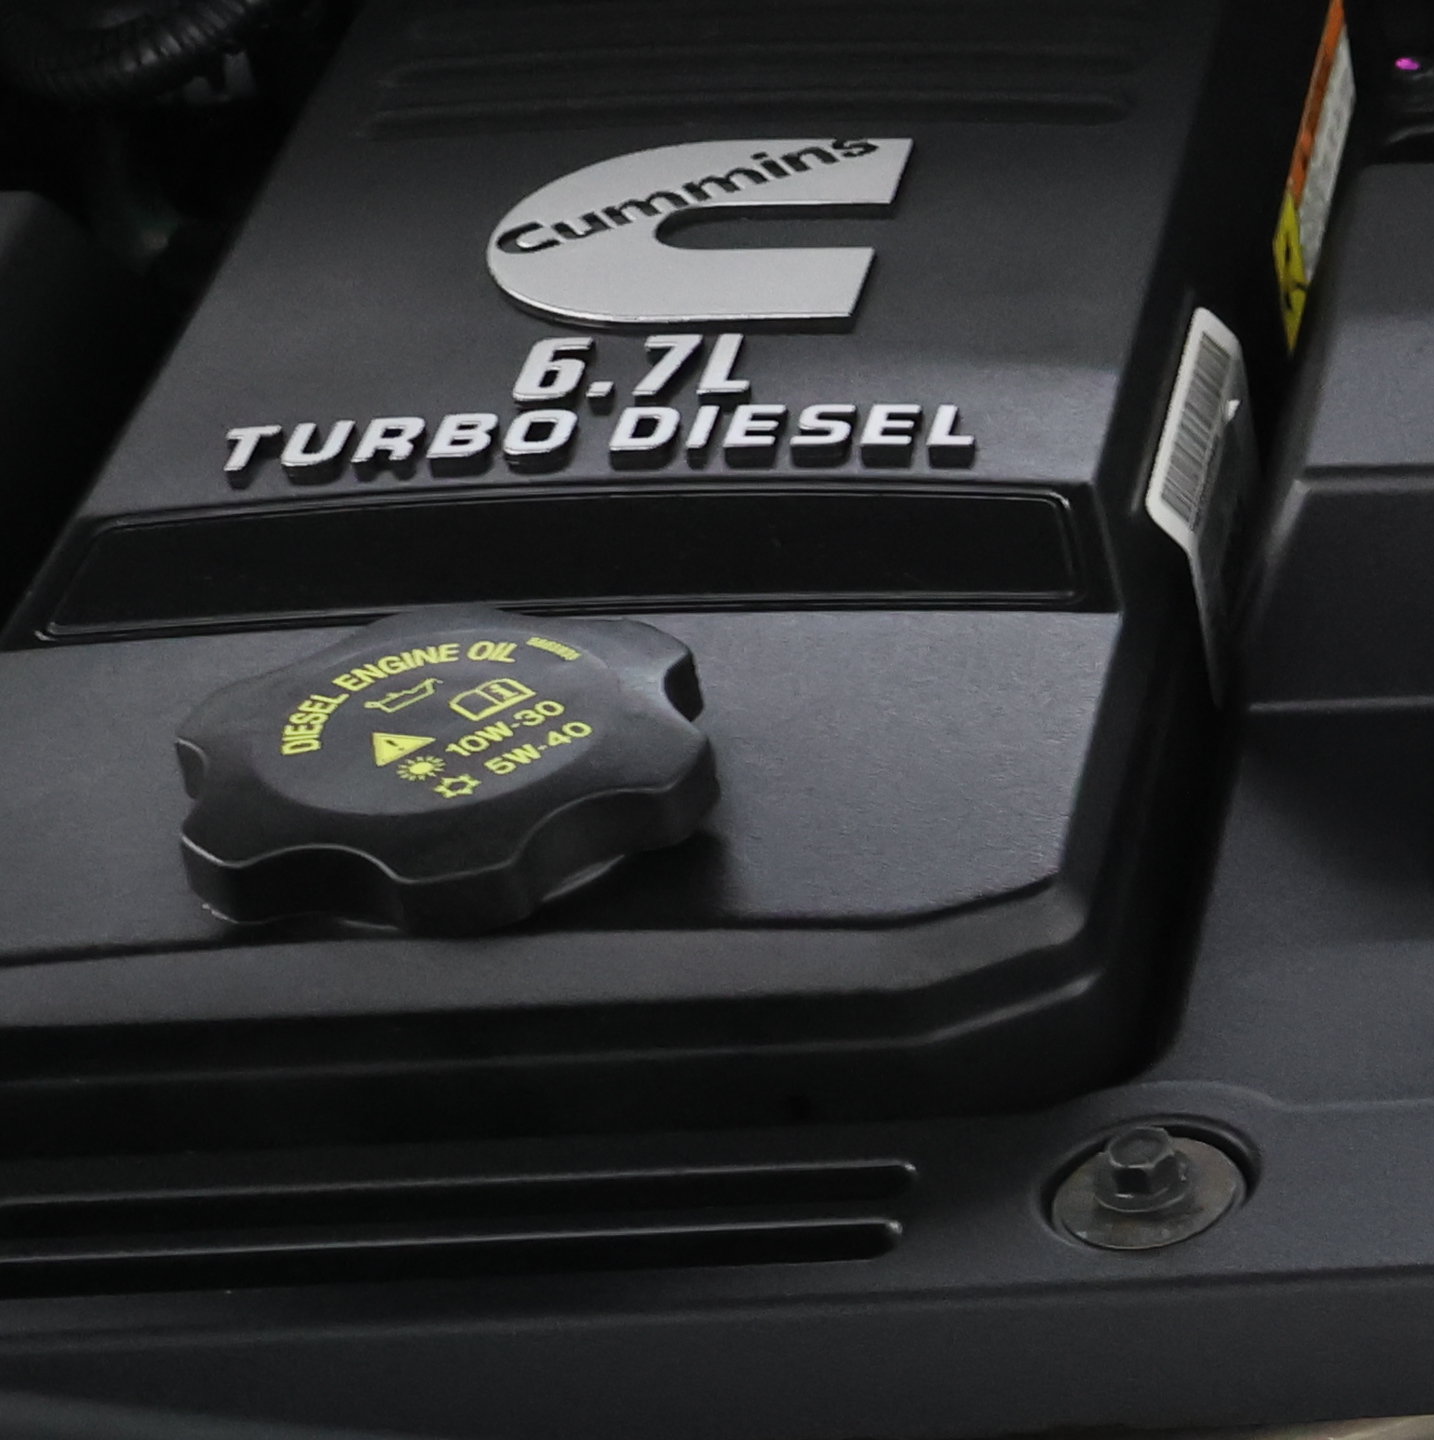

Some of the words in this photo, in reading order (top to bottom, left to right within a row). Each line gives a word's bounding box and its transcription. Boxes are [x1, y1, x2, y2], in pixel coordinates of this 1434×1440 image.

[496, 136, 879, 255] Cummins
[511, 332, 751, 403] 6.7L
[222, 409, 579, 473] TURBO
[608, 404, 976, 453] DIESEL
[281, 693, 350, 756] DIESEL
[332, 642, 461, 692] ENGINE
[466, 640, 518, 664] OIL
[446, 700, 566, 757] 10W-30
[484, 721, 593, 776] 5W-40
